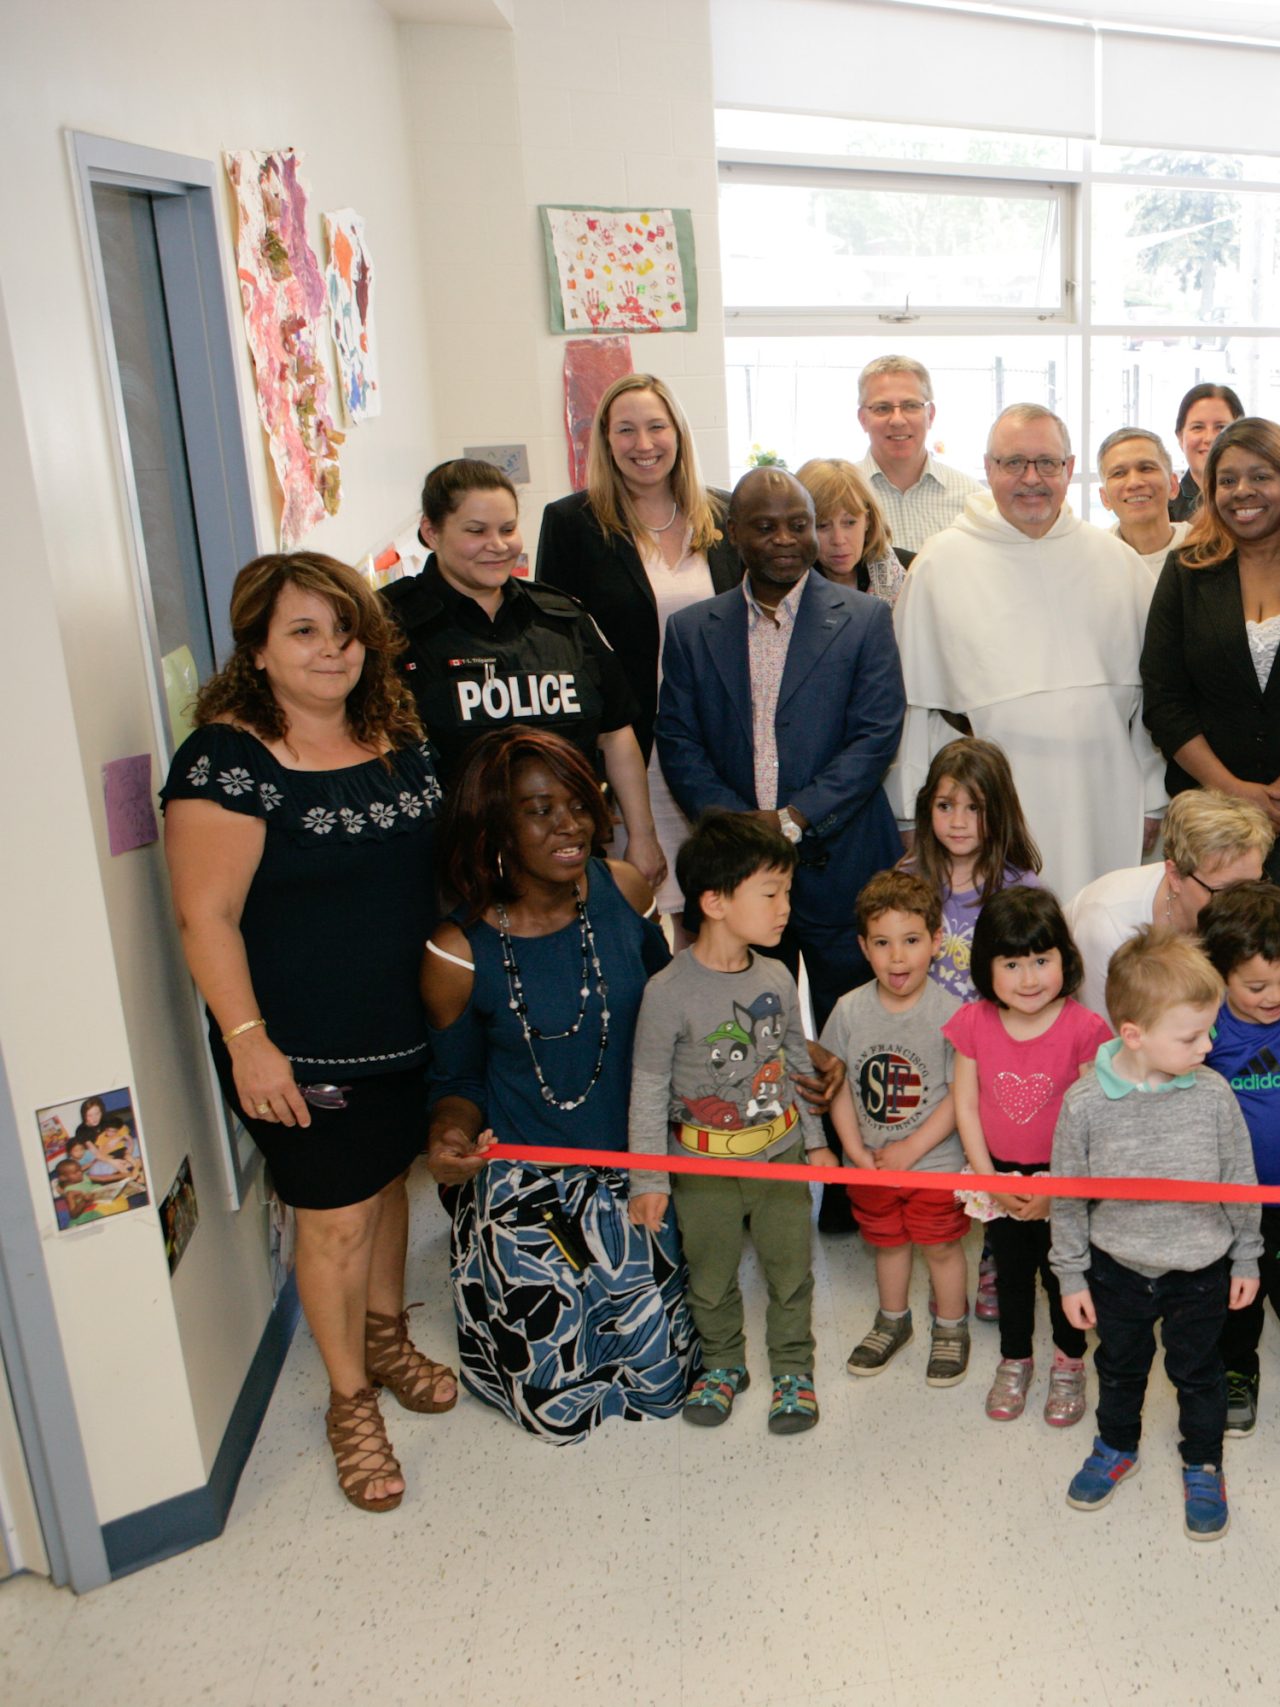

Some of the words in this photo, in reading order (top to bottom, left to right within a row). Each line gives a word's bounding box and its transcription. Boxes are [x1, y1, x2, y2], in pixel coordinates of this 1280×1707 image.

[457, 674, 581, 720] POLICE
[870, 1044, 929, 1078] FRANCISCO
[868, 1061, 911, 1113] SF
[858, 1104, 922, 1131] CALIFORNIA
